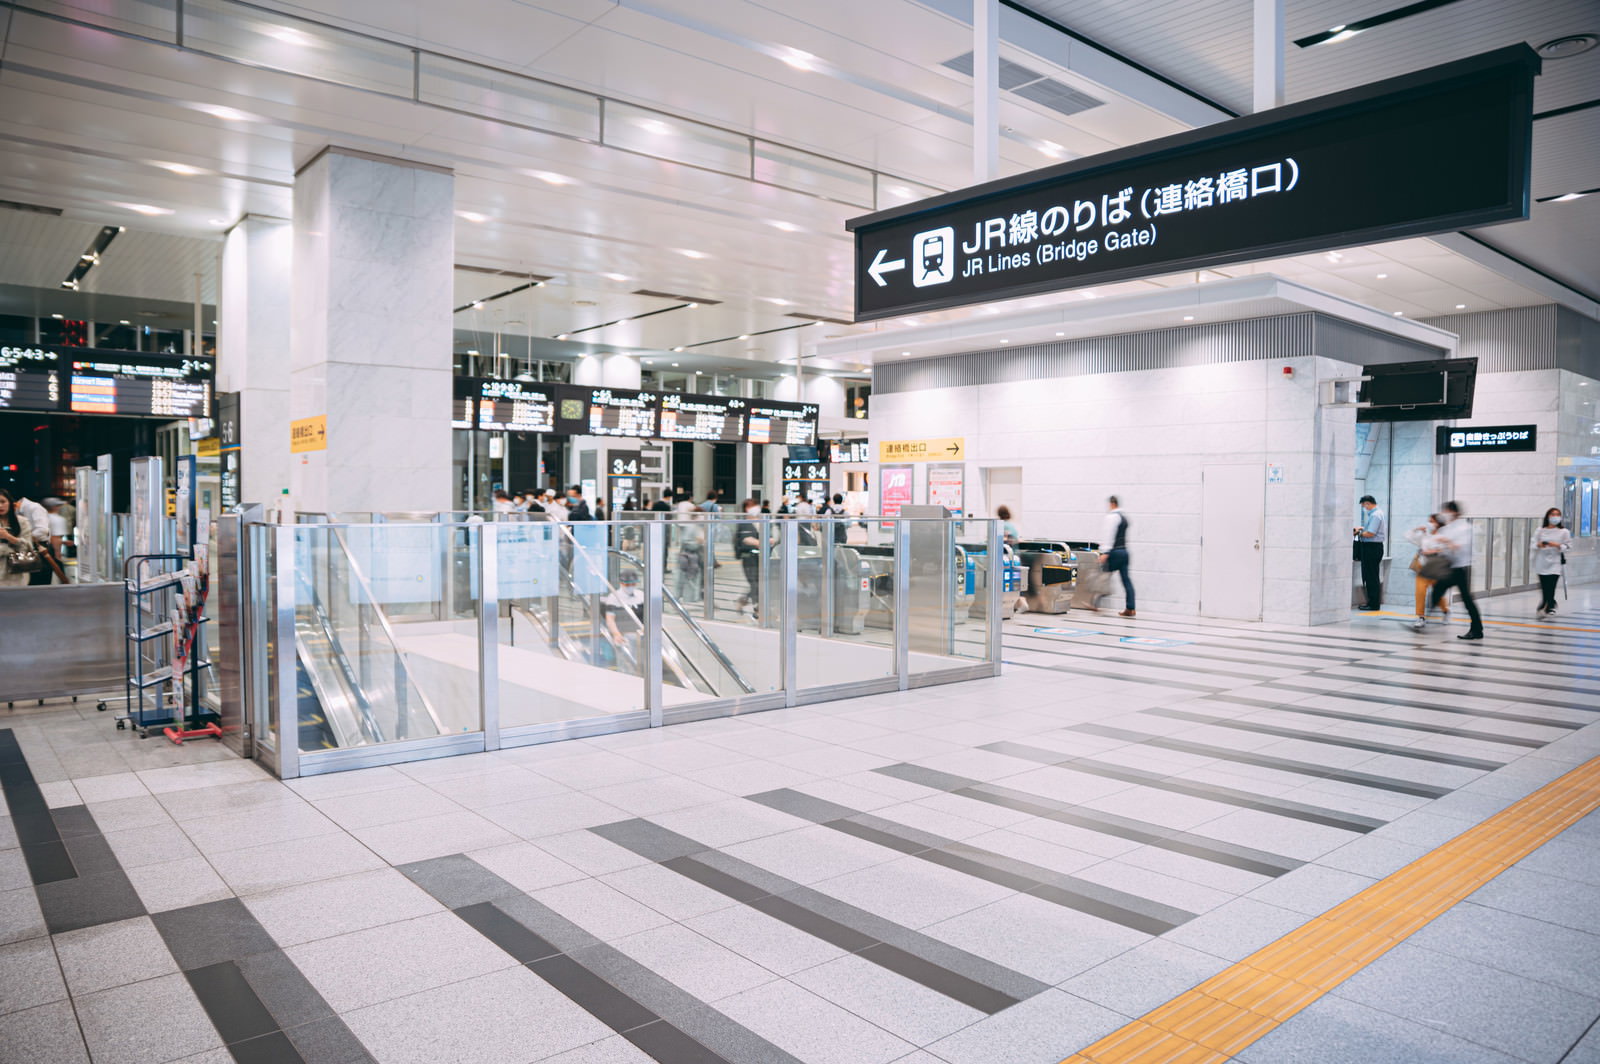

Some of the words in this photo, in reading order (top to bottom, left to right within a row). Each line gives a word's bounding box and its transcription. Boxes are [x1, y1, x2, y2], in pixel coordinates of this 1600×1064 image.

[963, 257, 983, 277] JR
[988, 252, 1031, 273] Lines
[1036, 238, 1098, 265] (Bridge
[1104, 224, 1156, 251] Gate)
